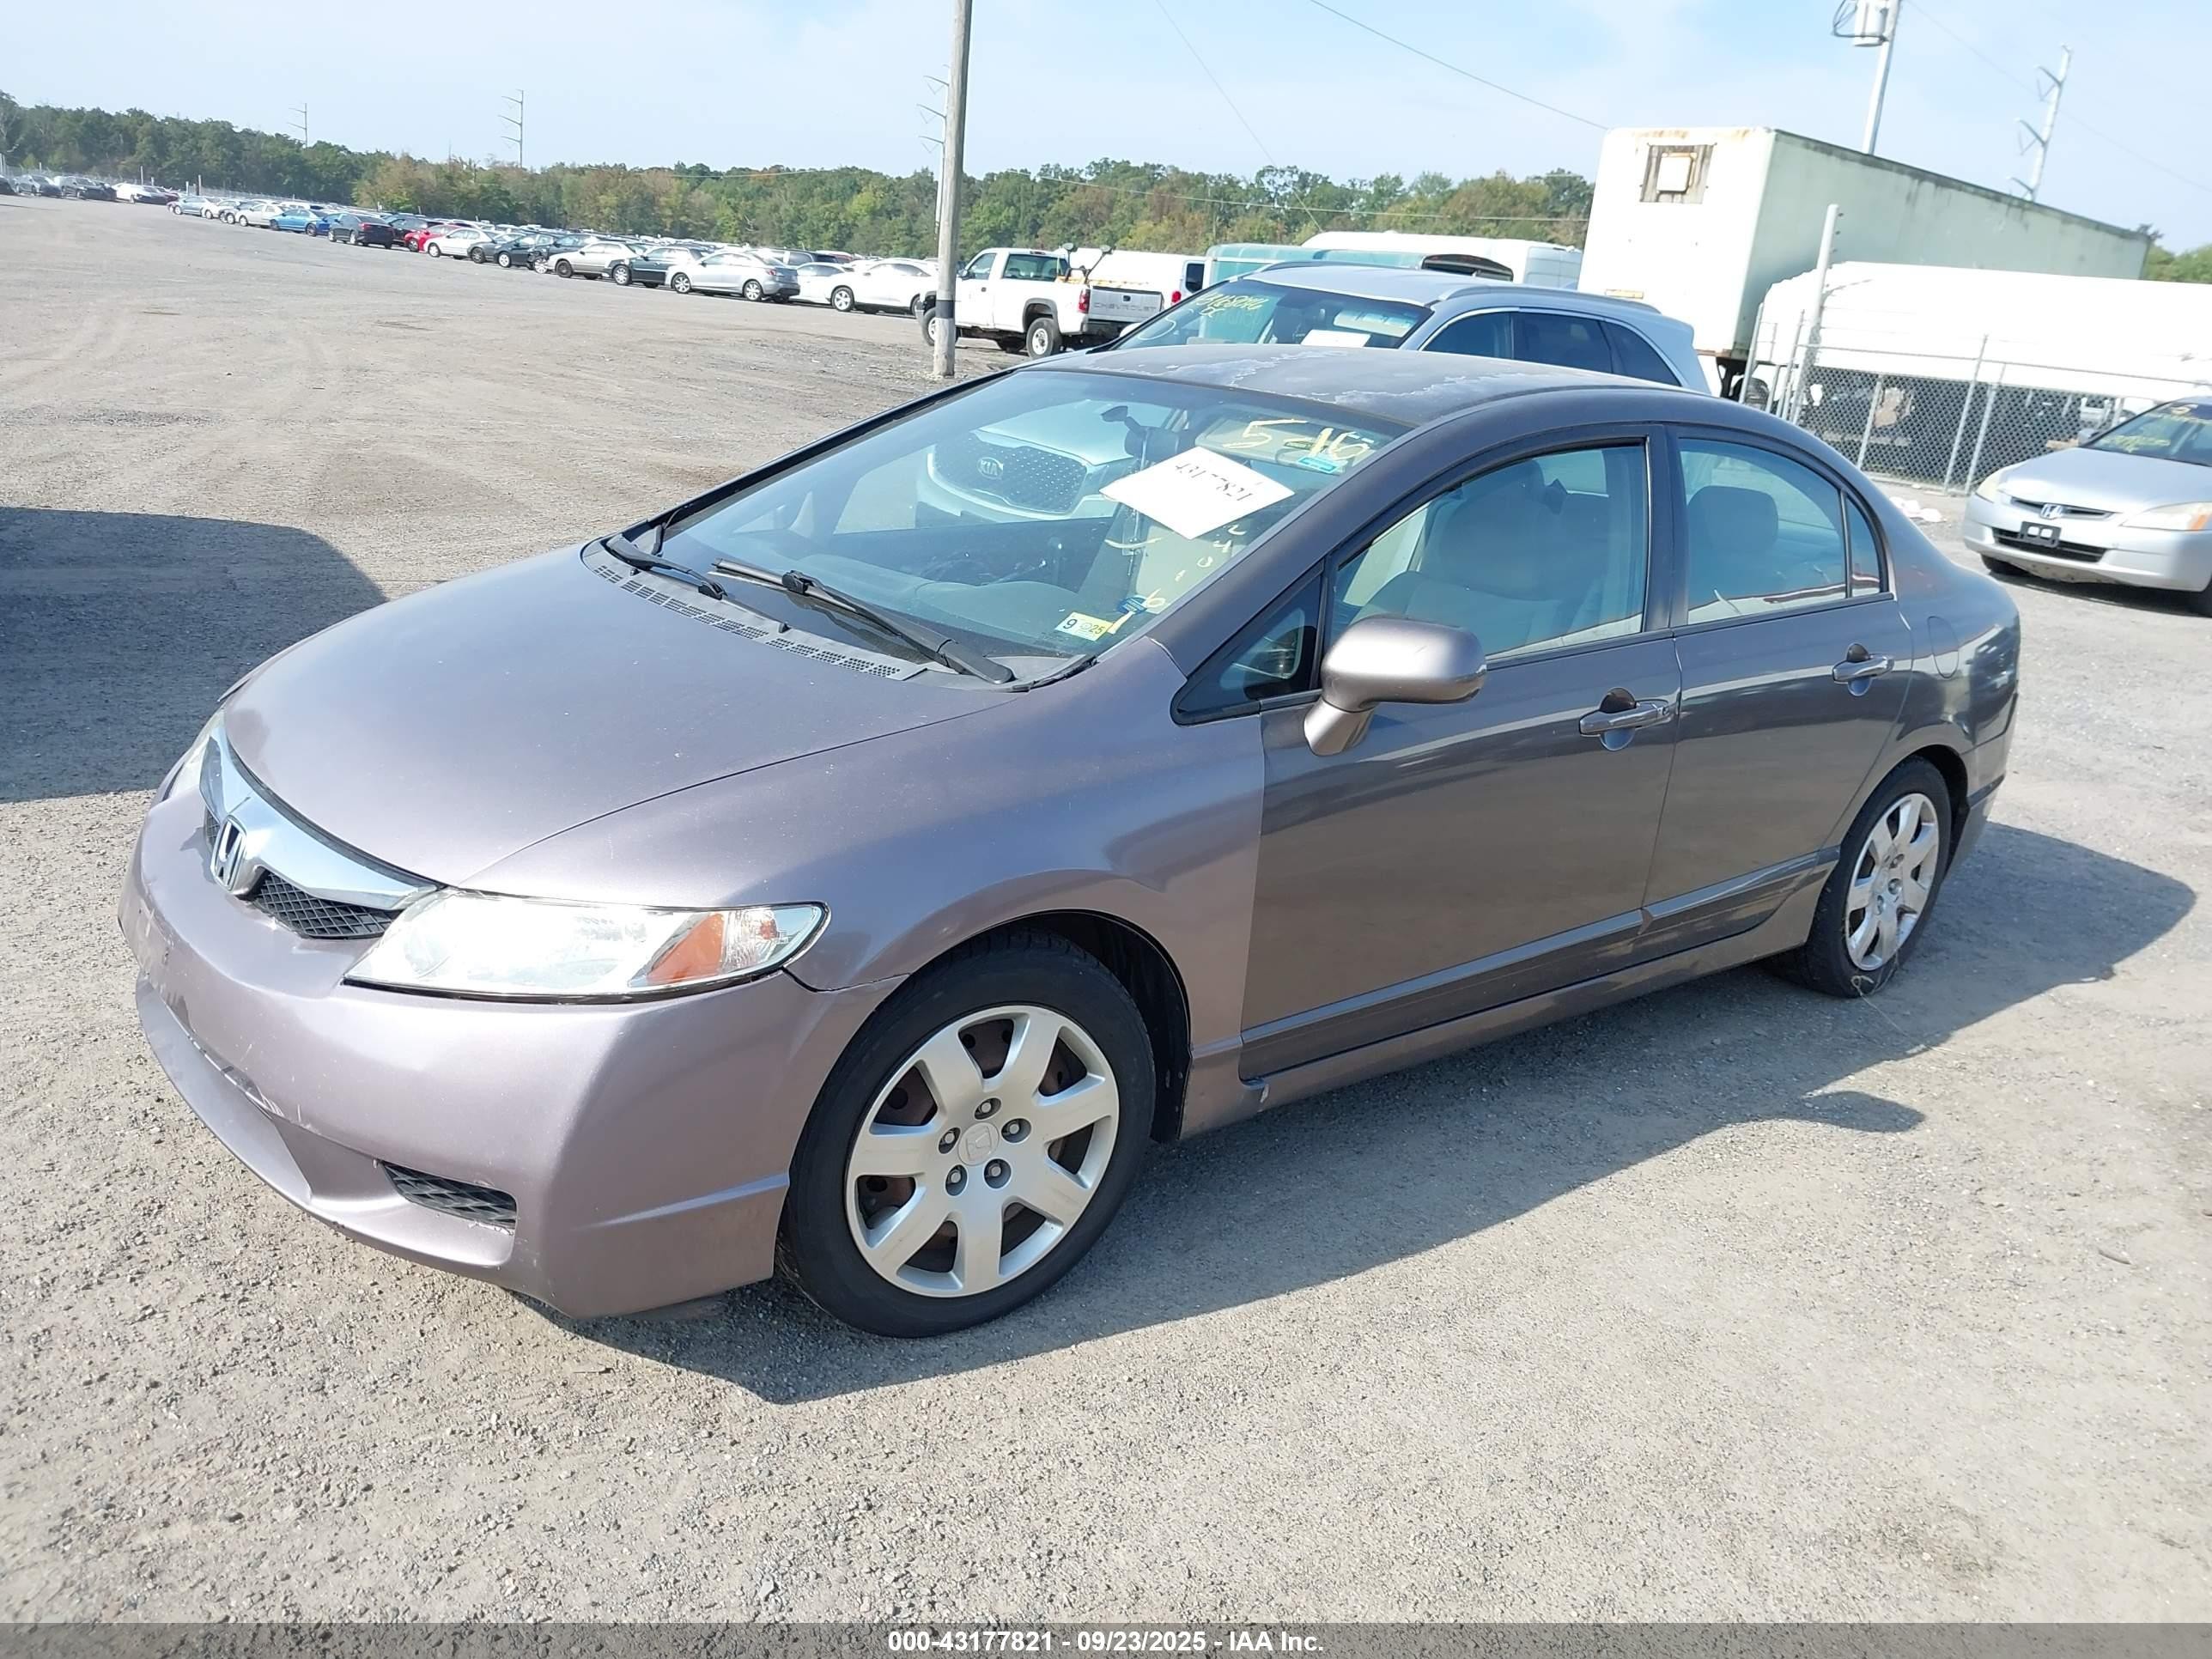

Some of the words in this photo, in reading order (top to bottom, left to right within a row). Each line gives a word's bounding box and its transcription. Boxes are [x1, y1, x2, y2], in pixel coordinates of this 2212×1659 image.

[1093, 301, 1157, 312] CHEVROLET
[1062, 618, 1078, 629] 9
[1089, 624, 1105, 635] 25
